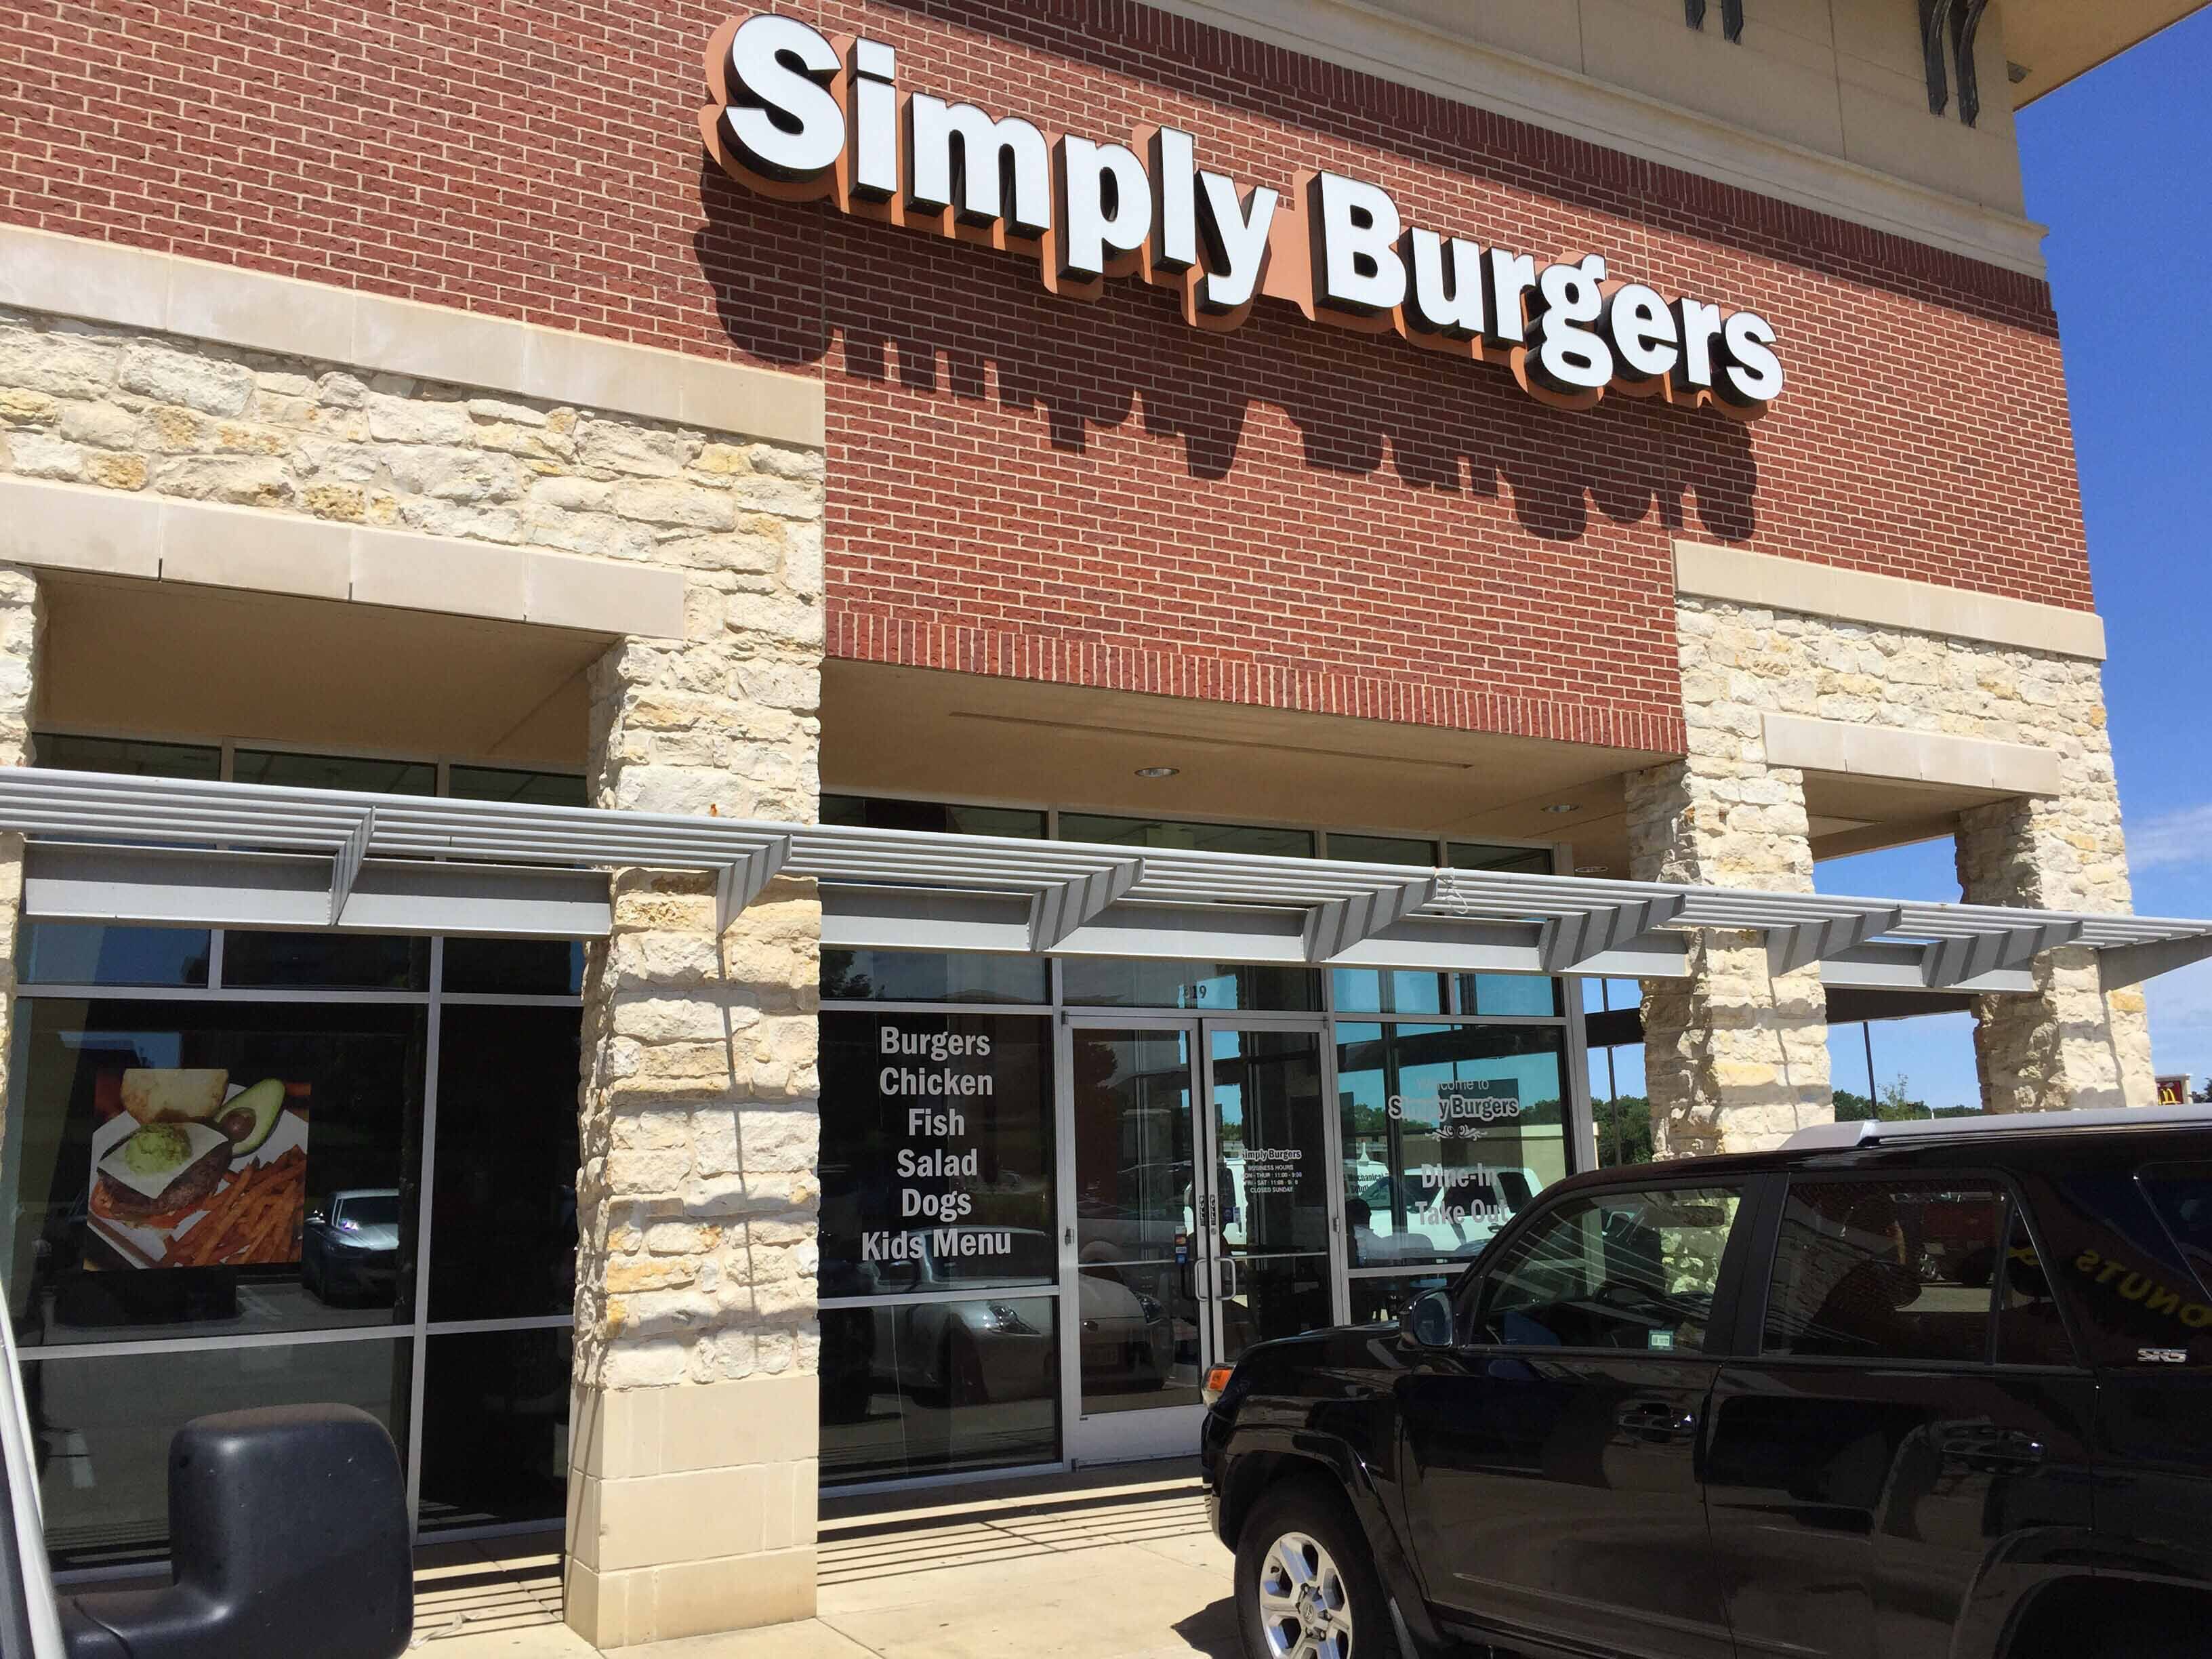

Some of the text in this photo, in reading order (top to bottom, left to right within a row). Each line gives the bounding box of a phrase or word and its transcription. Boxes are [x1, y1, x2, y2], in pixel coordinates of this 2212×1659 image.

[721, 12, 1785, 403] Simply Burgers
[881, 1026, 990, 1061] Burgers
[880, 1067, 993, 1095] Chicken
[1418, 1079, 1474, 1091] lcome
[908, 1108, 964, 1136] Fish
[1450, 1094, 1519, 1122] Burgers
[897, 1149, 977, 1178] Salad
[1268, 1148, 1302, 1162] Burgers
[1420, 1162, 1497, 1187] Dine-In
[902, 1189, 972, 1222] Dogs
[1414, 1199, 1509, 1225] Take Out
[862, 1229, 1011, 1261] Kids Menu
